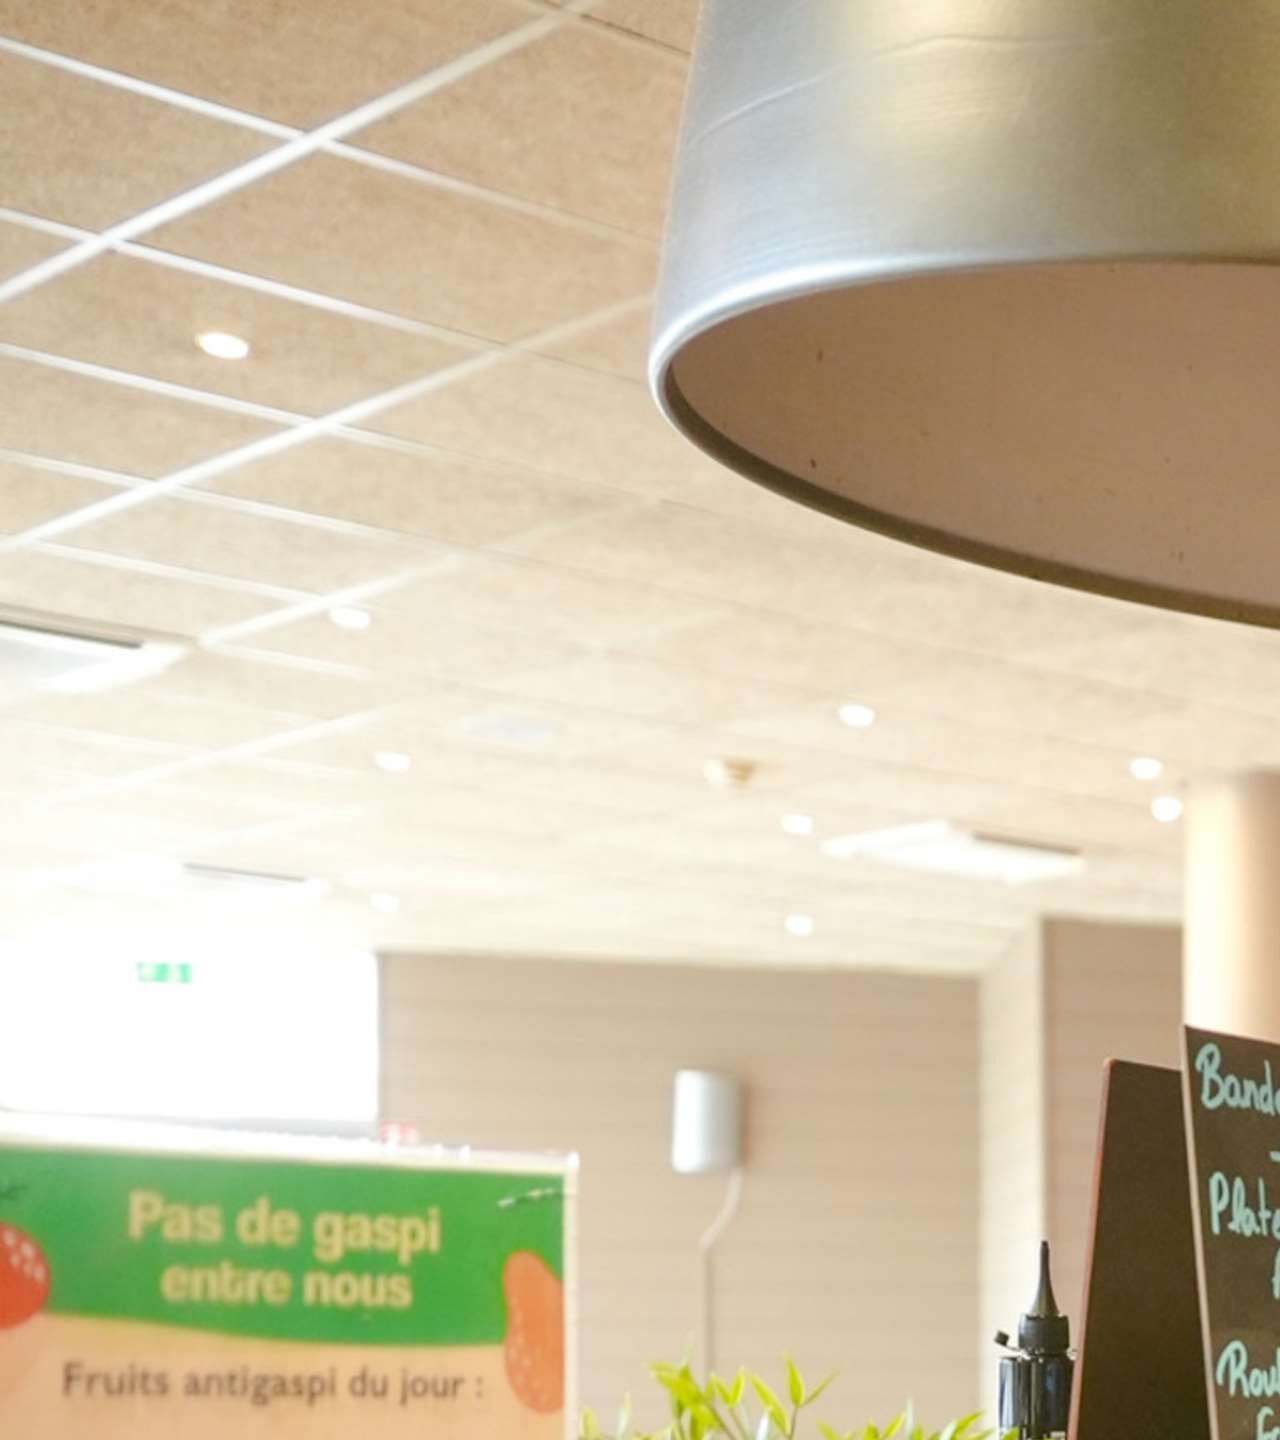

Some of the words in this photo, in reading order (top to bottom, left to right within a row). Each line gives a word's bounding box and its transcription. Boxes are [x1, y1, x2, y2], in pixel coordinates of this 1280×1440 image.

[127, 1189, 225, 1243] Pas
[236, 1196, 299, 1247] de
[313, 1207, 442, 1266] gaspi
[160, 1258, 292, 1304] entre
[303, 1271, 414, 1310] nous
[62, 1360, 171, 1398] Fruits
[183, 1364, 338, 1406] antigaspi
[349, 1366, 389, 1400] du
[399, 1366, 467, 1405] jour
